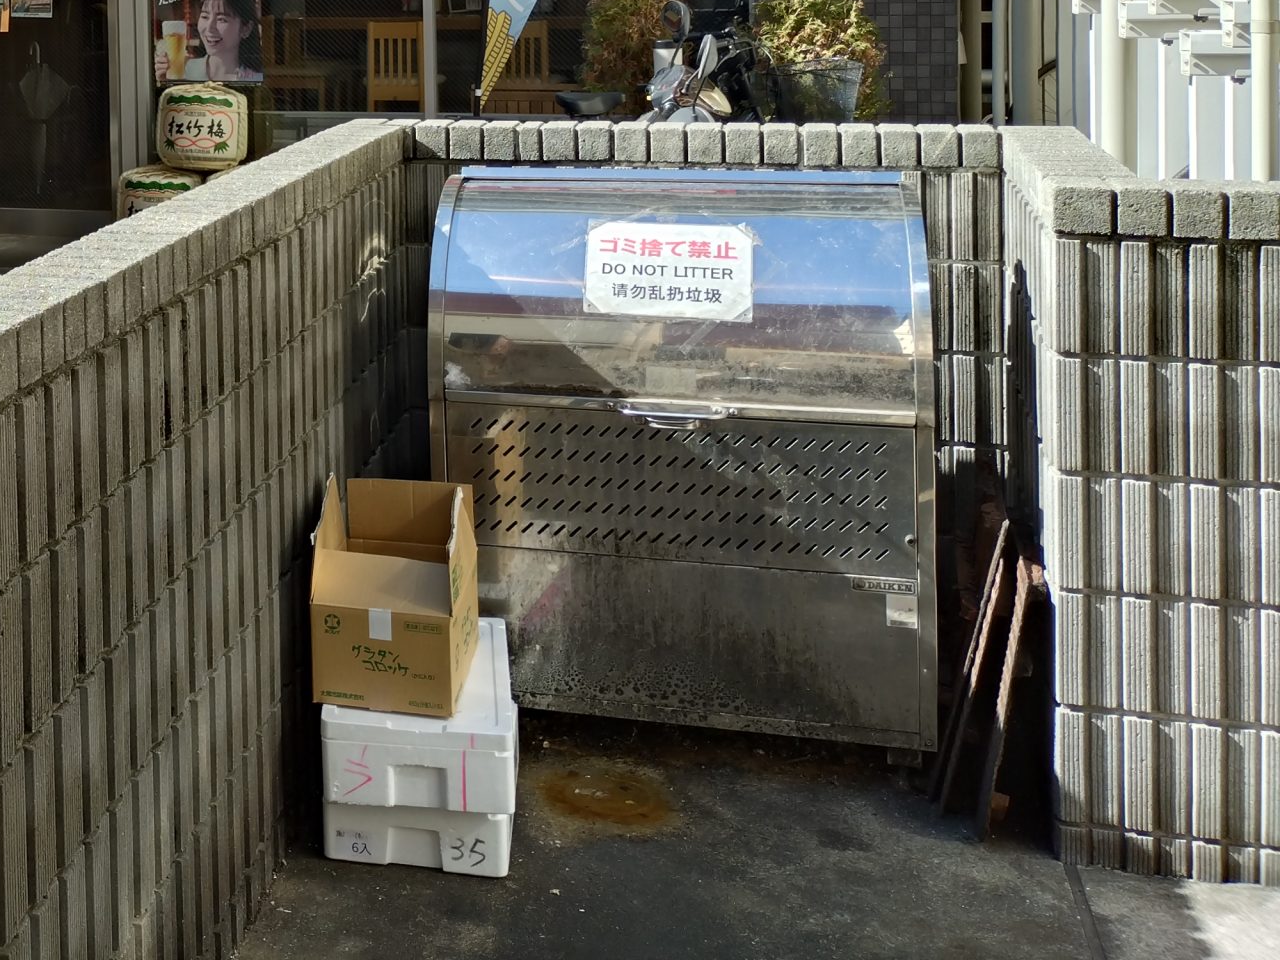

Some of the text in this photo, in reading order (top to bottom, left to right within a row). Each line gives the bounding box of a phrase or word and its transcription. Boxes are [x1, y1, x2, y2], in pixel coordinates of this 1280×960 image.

[168, 116, 226, 138] 松竹梅
[599, 238, 738, 259] ゴミ捨て禁止
[602, 263, 733, 280] DO NOT LITTER
[612, 283, 722, 304] 请勿乱扔垃圾
[867, 581, 913, 592] DAIKEN
[352, 644, 400, 662] グラタン
[362, 659, 409, 677] コロッケ
[352, 842, 372, 855] 6入
[451, 838, 486, 867] 35
